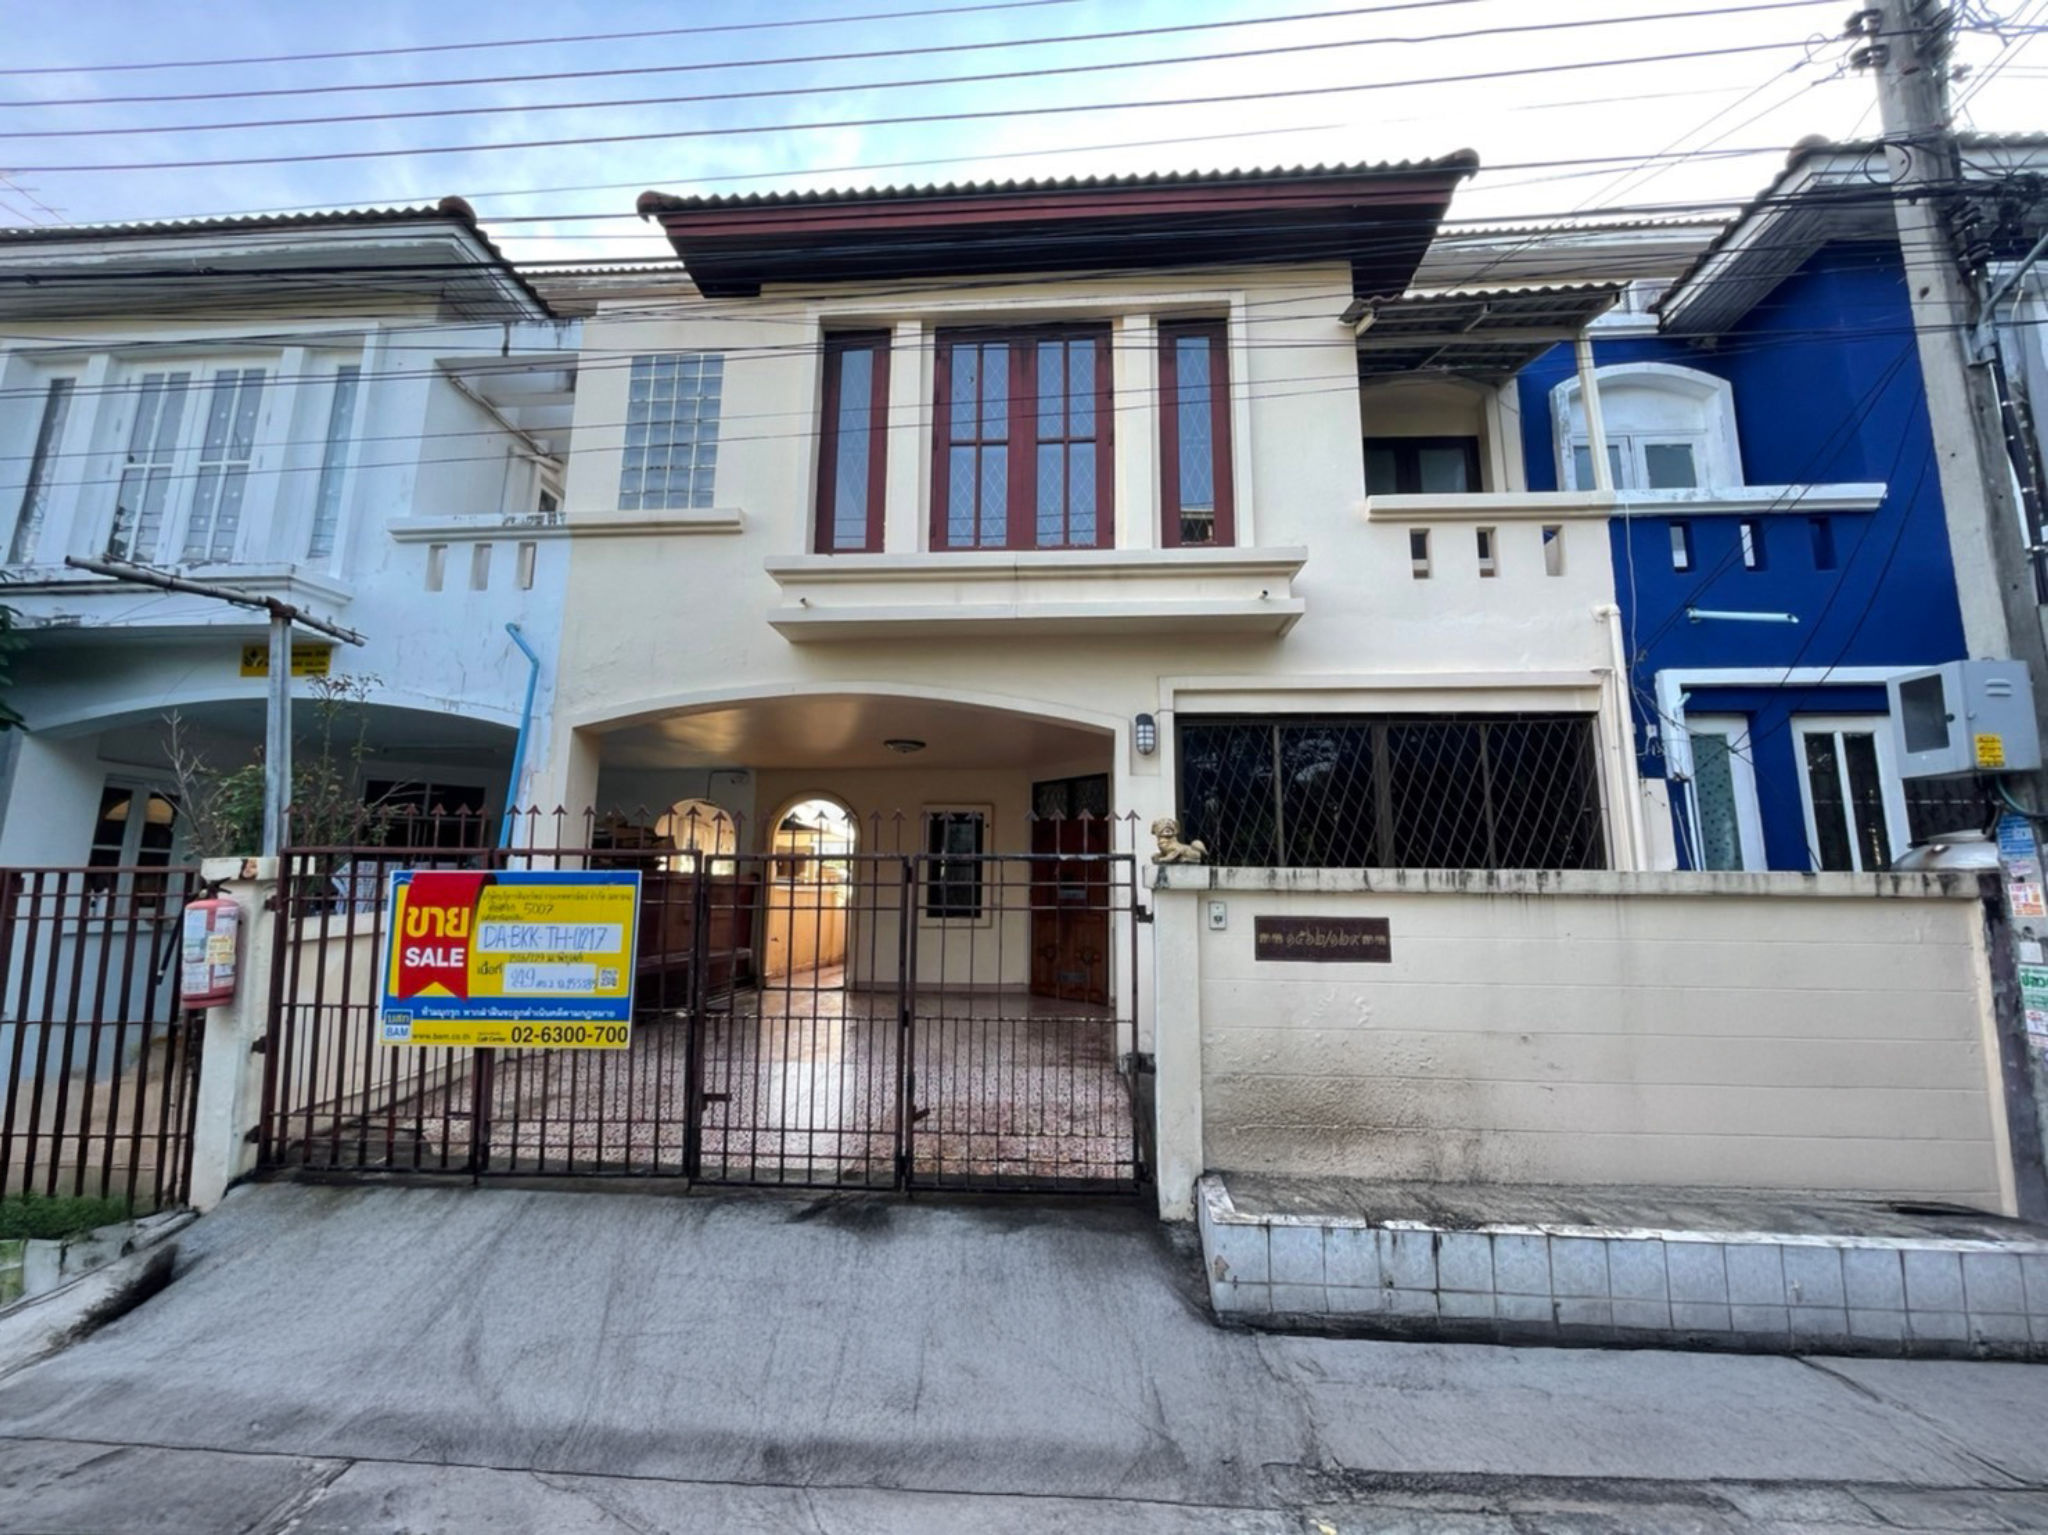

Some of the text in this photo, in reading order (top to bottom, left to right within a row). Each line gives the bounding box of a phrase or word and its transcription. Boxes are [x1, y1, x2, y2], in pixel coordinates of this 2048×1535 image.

[406, 906, 470, 937] ขาย
[404, 947, 464, 968] SALE
[386, 1027, 409, 1037] BAM
[511, 1026, 628, 1043] 02-6300-700
